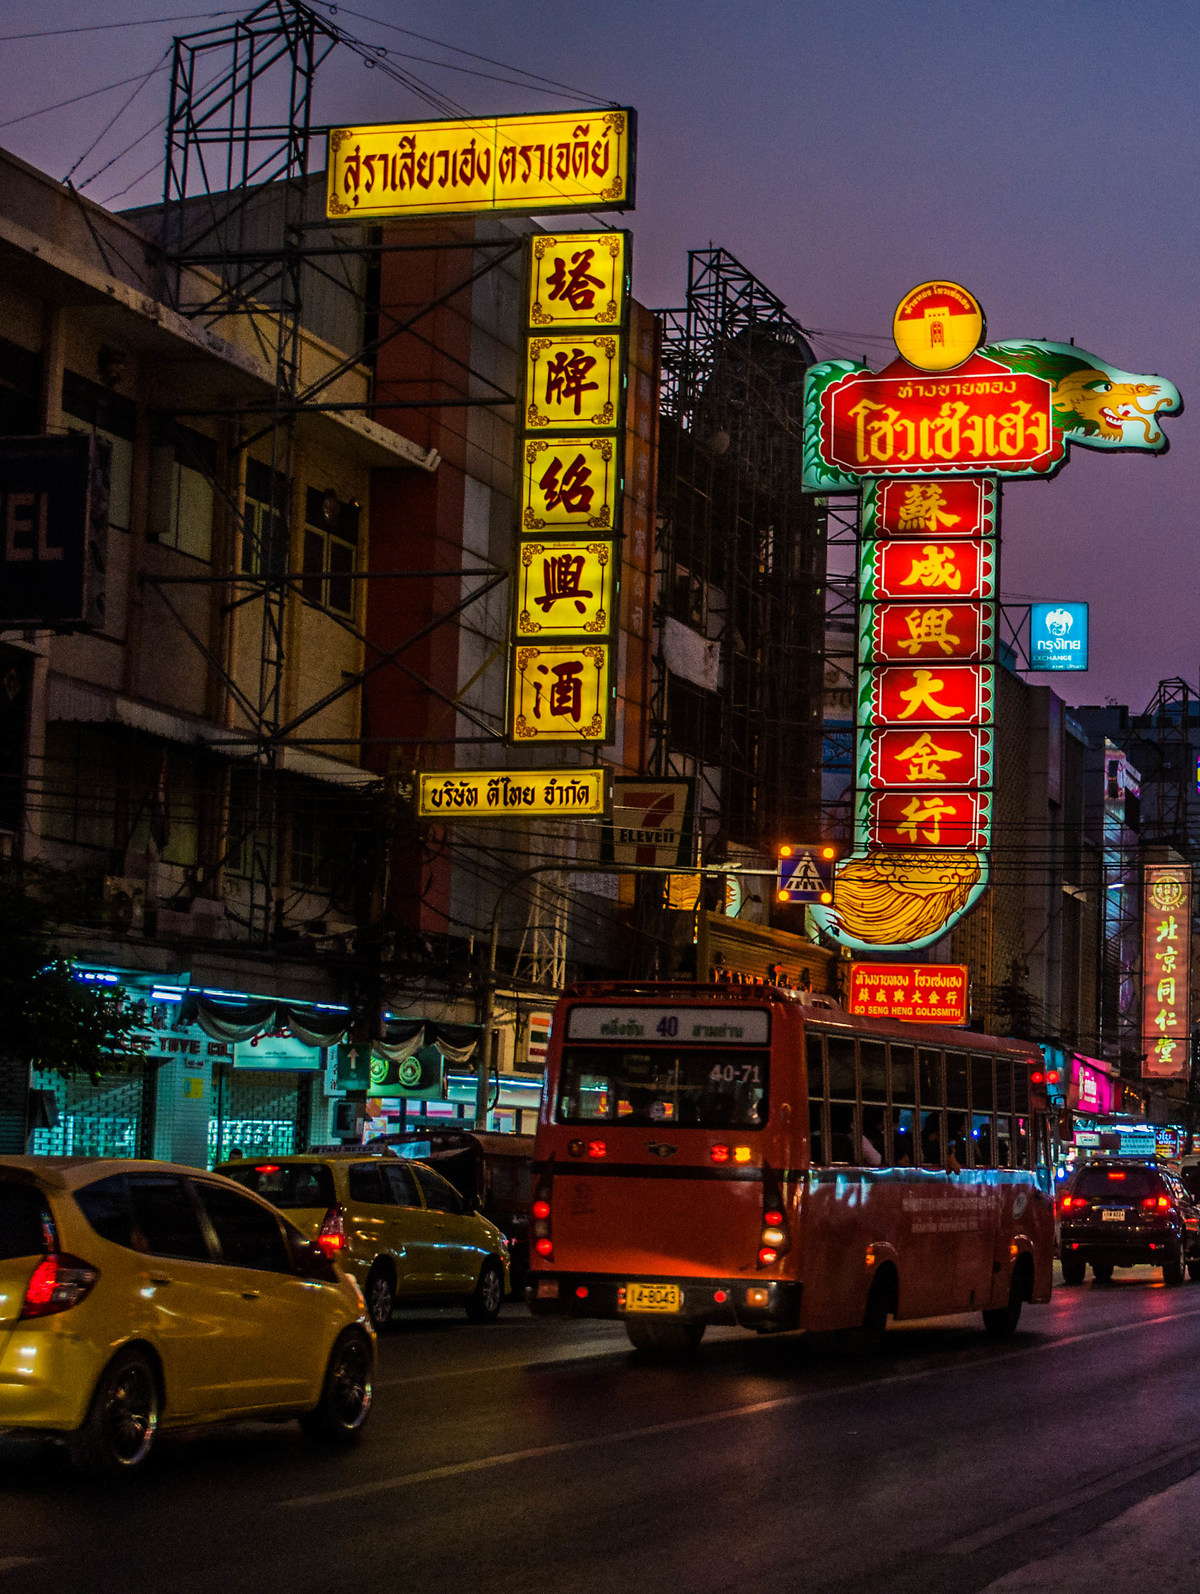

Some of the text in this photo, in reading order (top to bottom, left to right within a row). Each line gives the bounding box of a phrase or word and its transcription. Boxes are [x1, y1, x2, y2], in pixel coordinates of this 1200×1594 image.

[499, 124, 612, 186] ตราเจดีย์
[897, 380, 1017, 399] ห้างขายทอง
[533, 248, 606, 723] 塔牌紹興酒
[1037, 637, 1081, 653] กรุงไทย
[894, 484, 964, 844] 蘇成興大金行
[431, 780, 478, 808] บริษัท
[544, 778, 590, 806] จำกัด
[855, 970, 909, 986] ห้างขายทอง
[1155, 915, 1178, 1063] 北京同仁堂
[854, 1005, 961, 1017] SO SENG HENG GOLDSMITH
[656, 1016, 680, 1037] 40
[710, 1064, 761, 1084] 40-71
